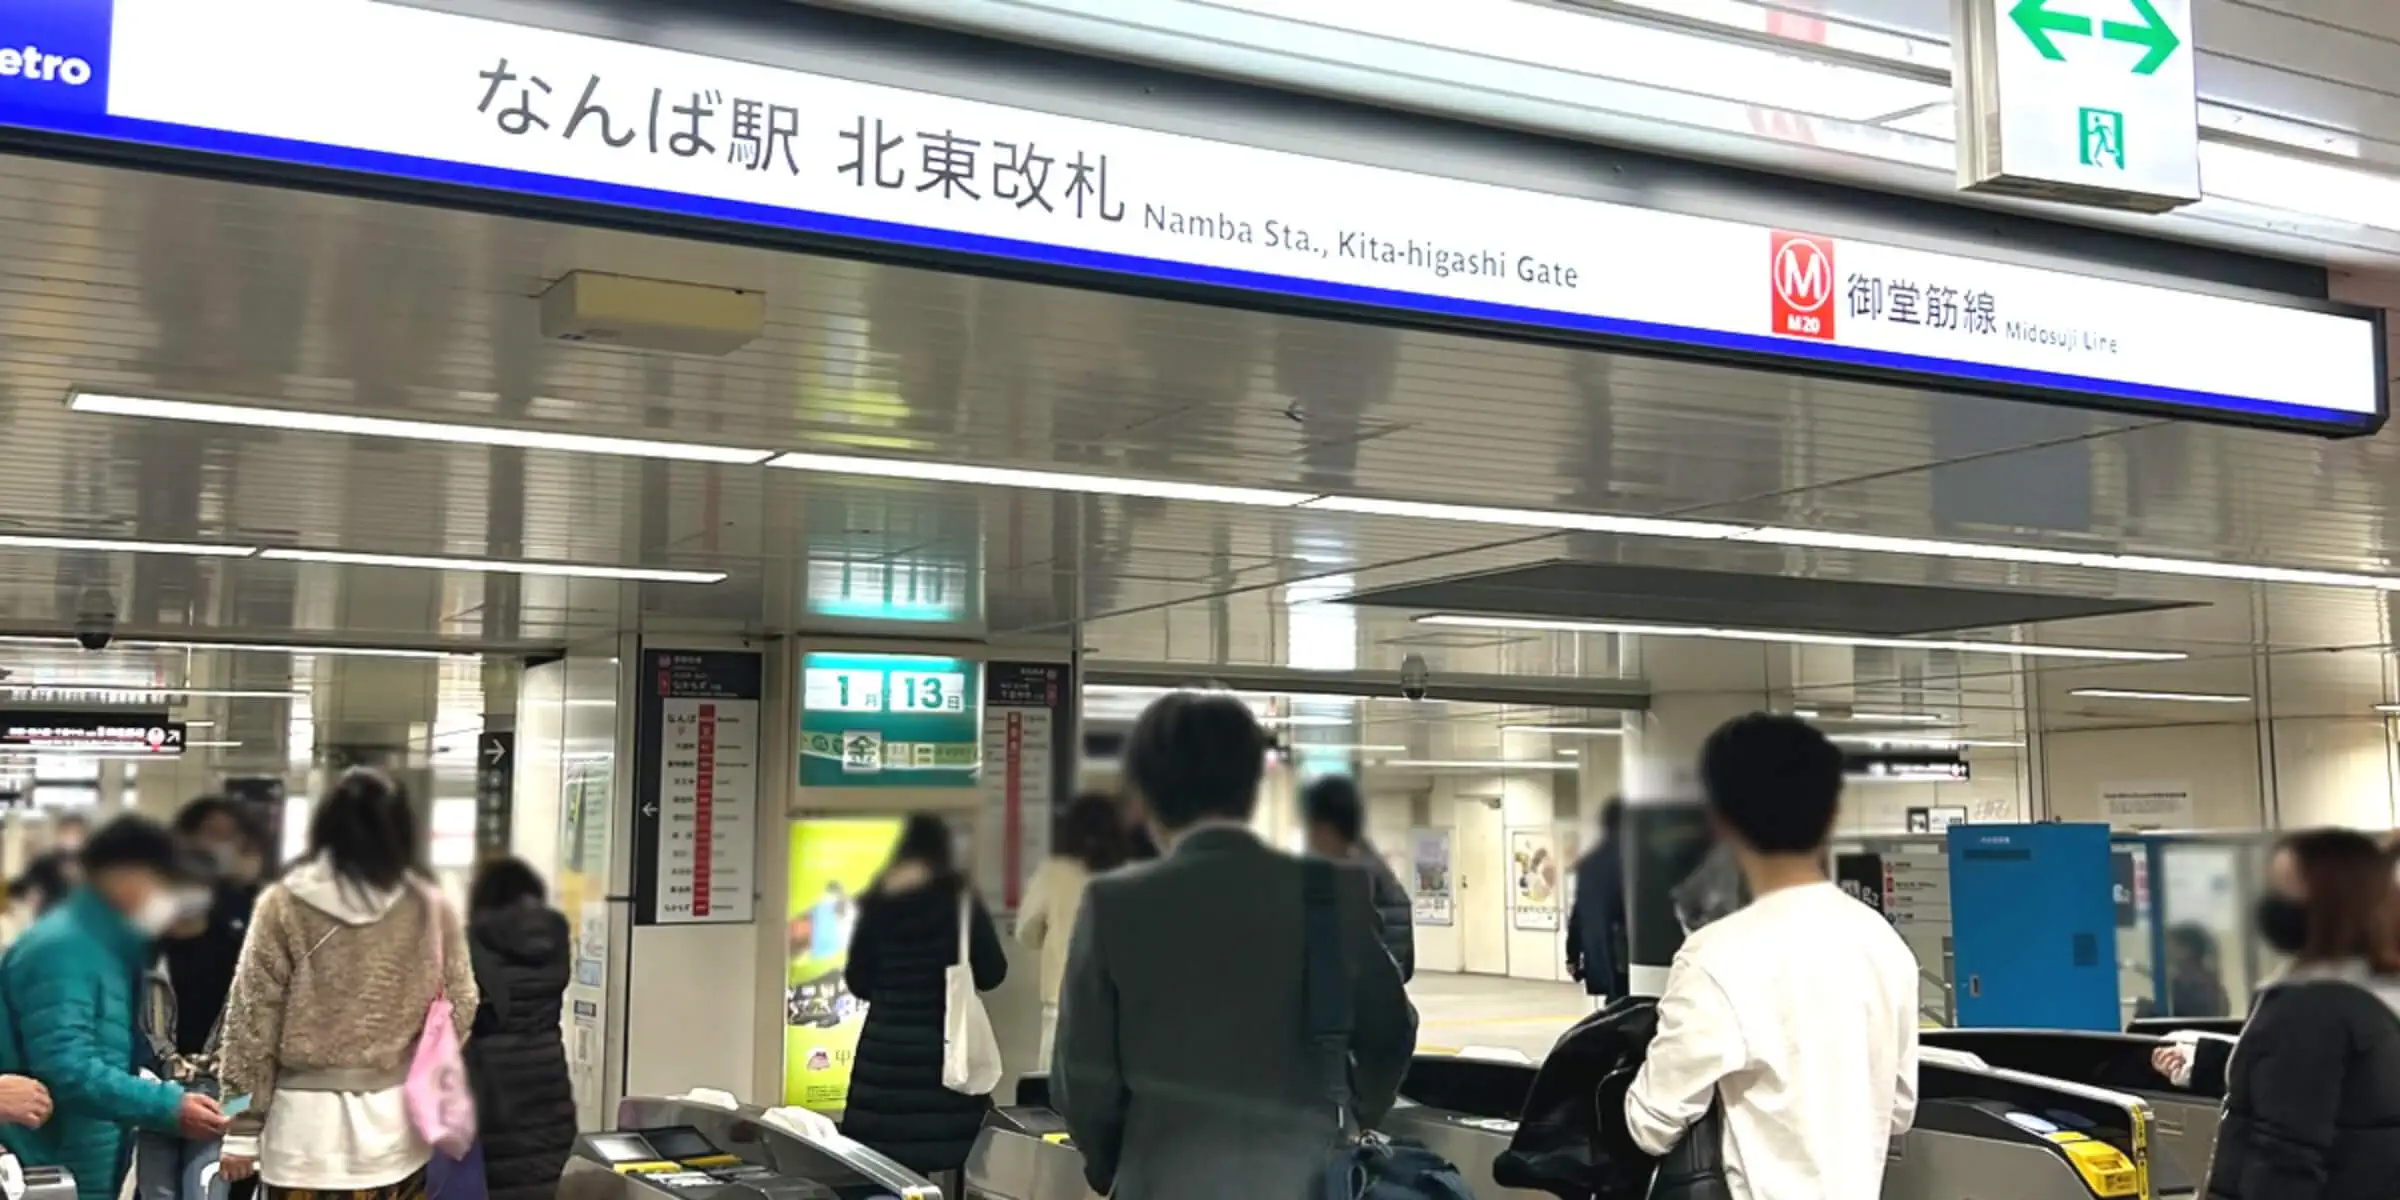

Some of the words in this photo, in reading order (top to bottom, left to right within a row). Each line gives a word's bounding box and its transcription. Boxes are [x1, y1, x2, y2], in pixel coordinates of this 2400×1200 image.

[0, 44, 92, 86] etro
[476, 56, 801, 178] なんば駅
[836, 114, 1127, 224] 北東改札
[1144, 203, 1252, 243] Namba
[1265, 219, 1328, 258] Sta.,
[1338, 230, 1505, 279] Kita-higashi
[1517, 256, 1578, 289] Gate
[1786, 313, 1820, 335] M20
[1847, 273, 1998, 336] 御堂筋線
[2005, 321, 2078, 353] Midosuji
[2083, 331, 2120, 355] Line
